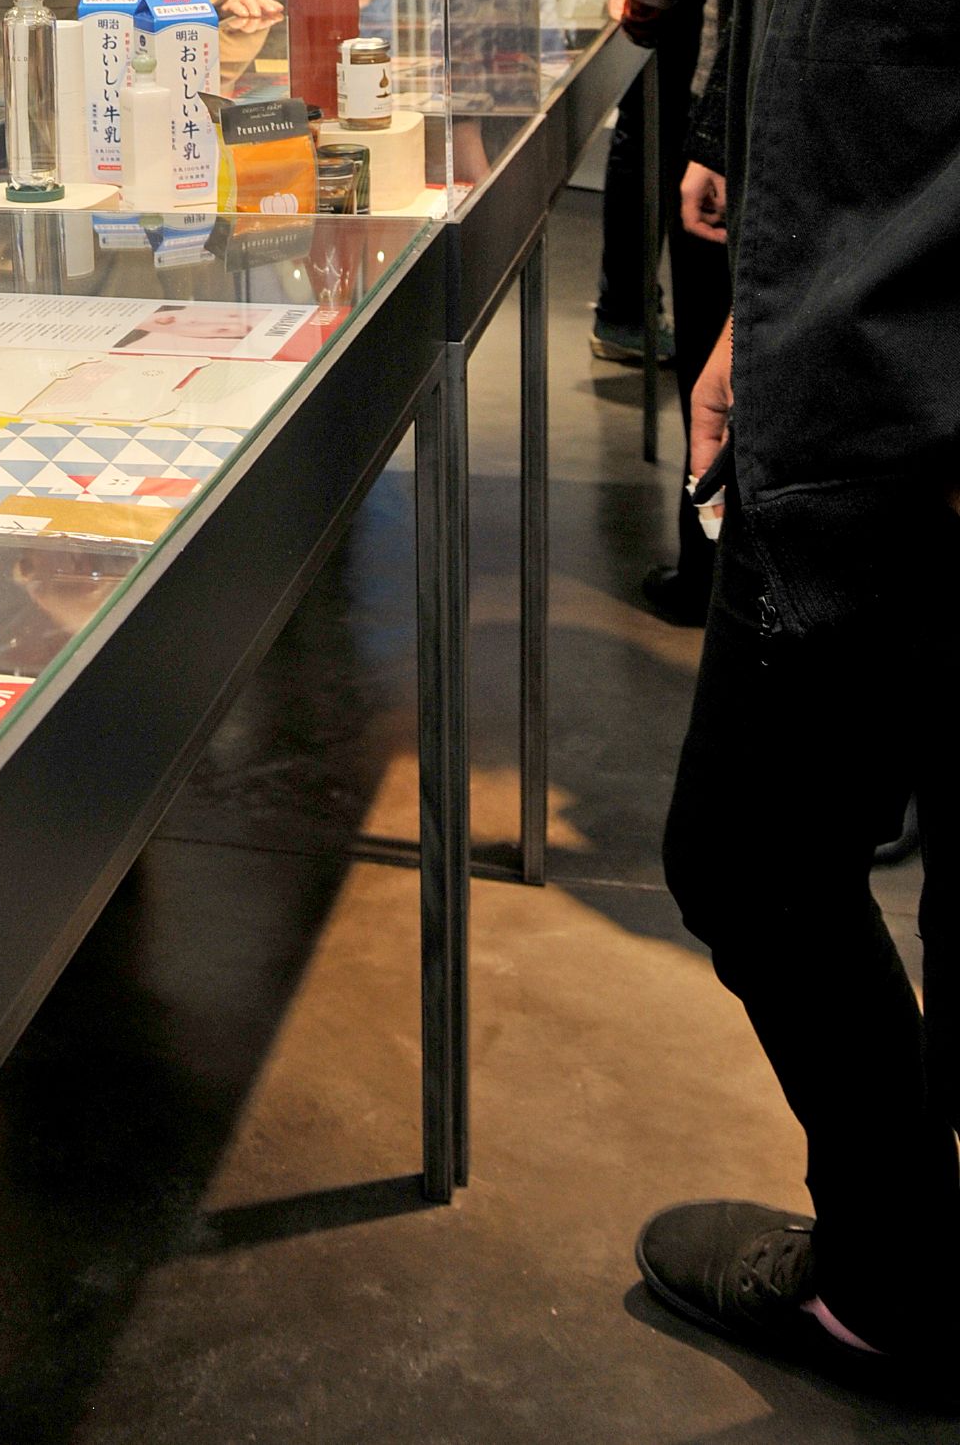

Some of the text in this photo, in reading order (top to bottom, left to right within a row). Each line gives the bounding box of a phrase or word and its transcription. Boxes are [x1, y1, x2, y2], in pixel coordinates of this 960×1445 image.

[97, 19, 119, 30] 明治
[175, 30, 198, 41] 明治
[102, 33, 121, 144] おいしい牛乳
[180, 46, 201, 161] おいしい牛乳
